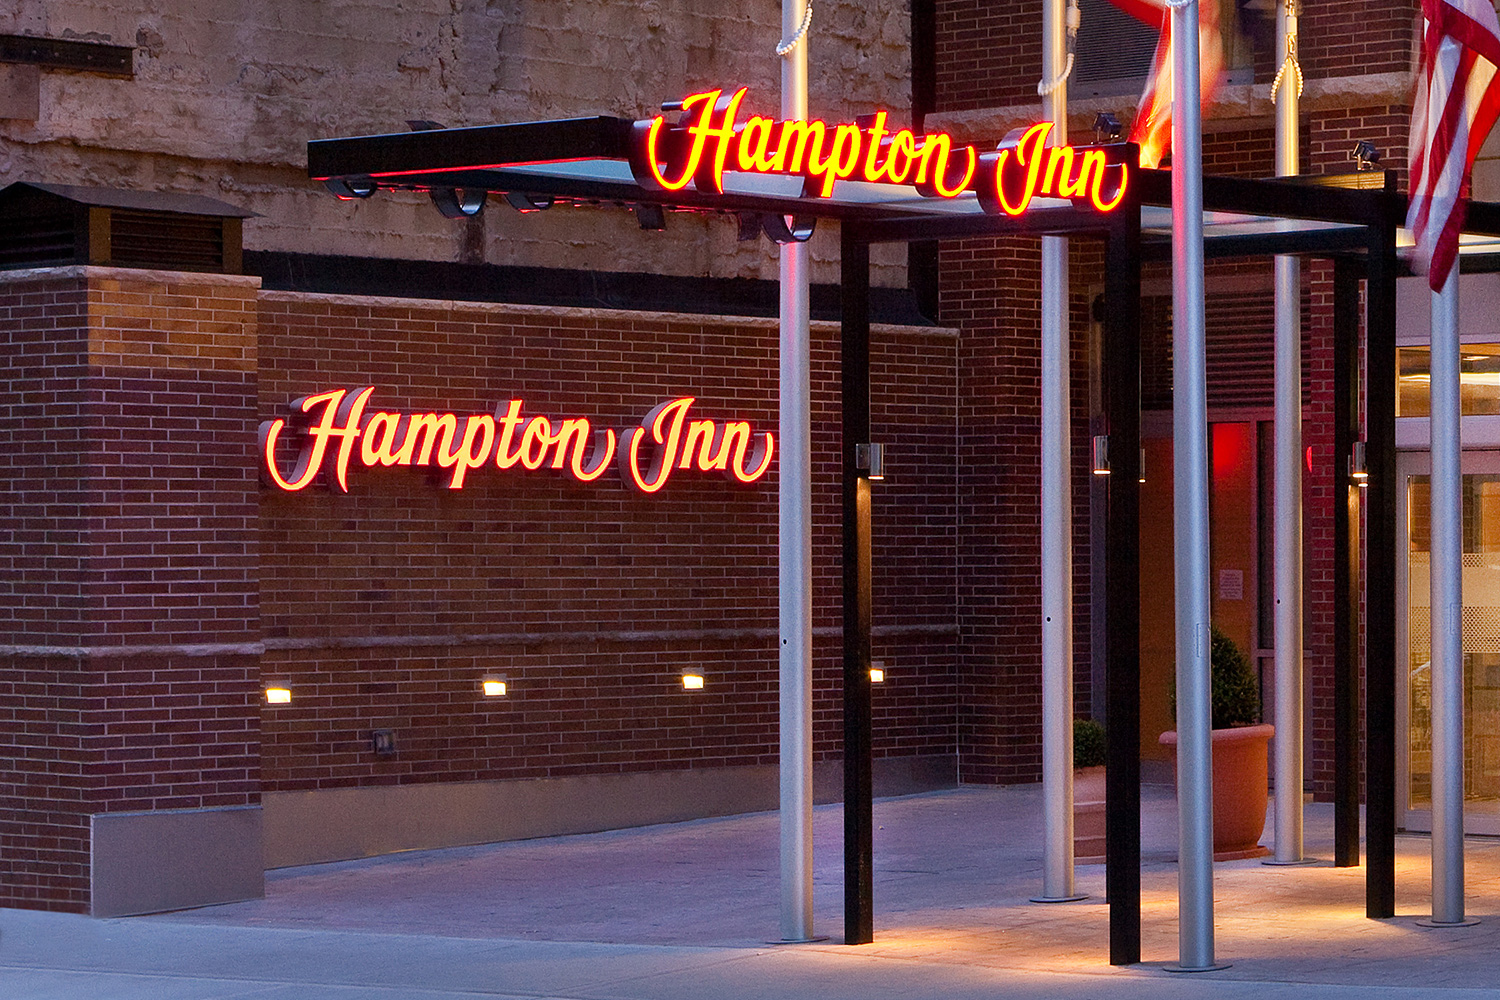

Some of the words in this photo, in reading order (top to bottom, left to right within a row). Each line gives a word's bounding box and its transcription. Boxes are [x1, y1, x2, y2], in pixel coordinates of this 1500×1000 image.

[648, 86, 976, 198] Hampton
[996, 121, 1128, 215] Inn
[264, 386, 616, 493] Hampton
[630, 397, 774, 493] Inn
